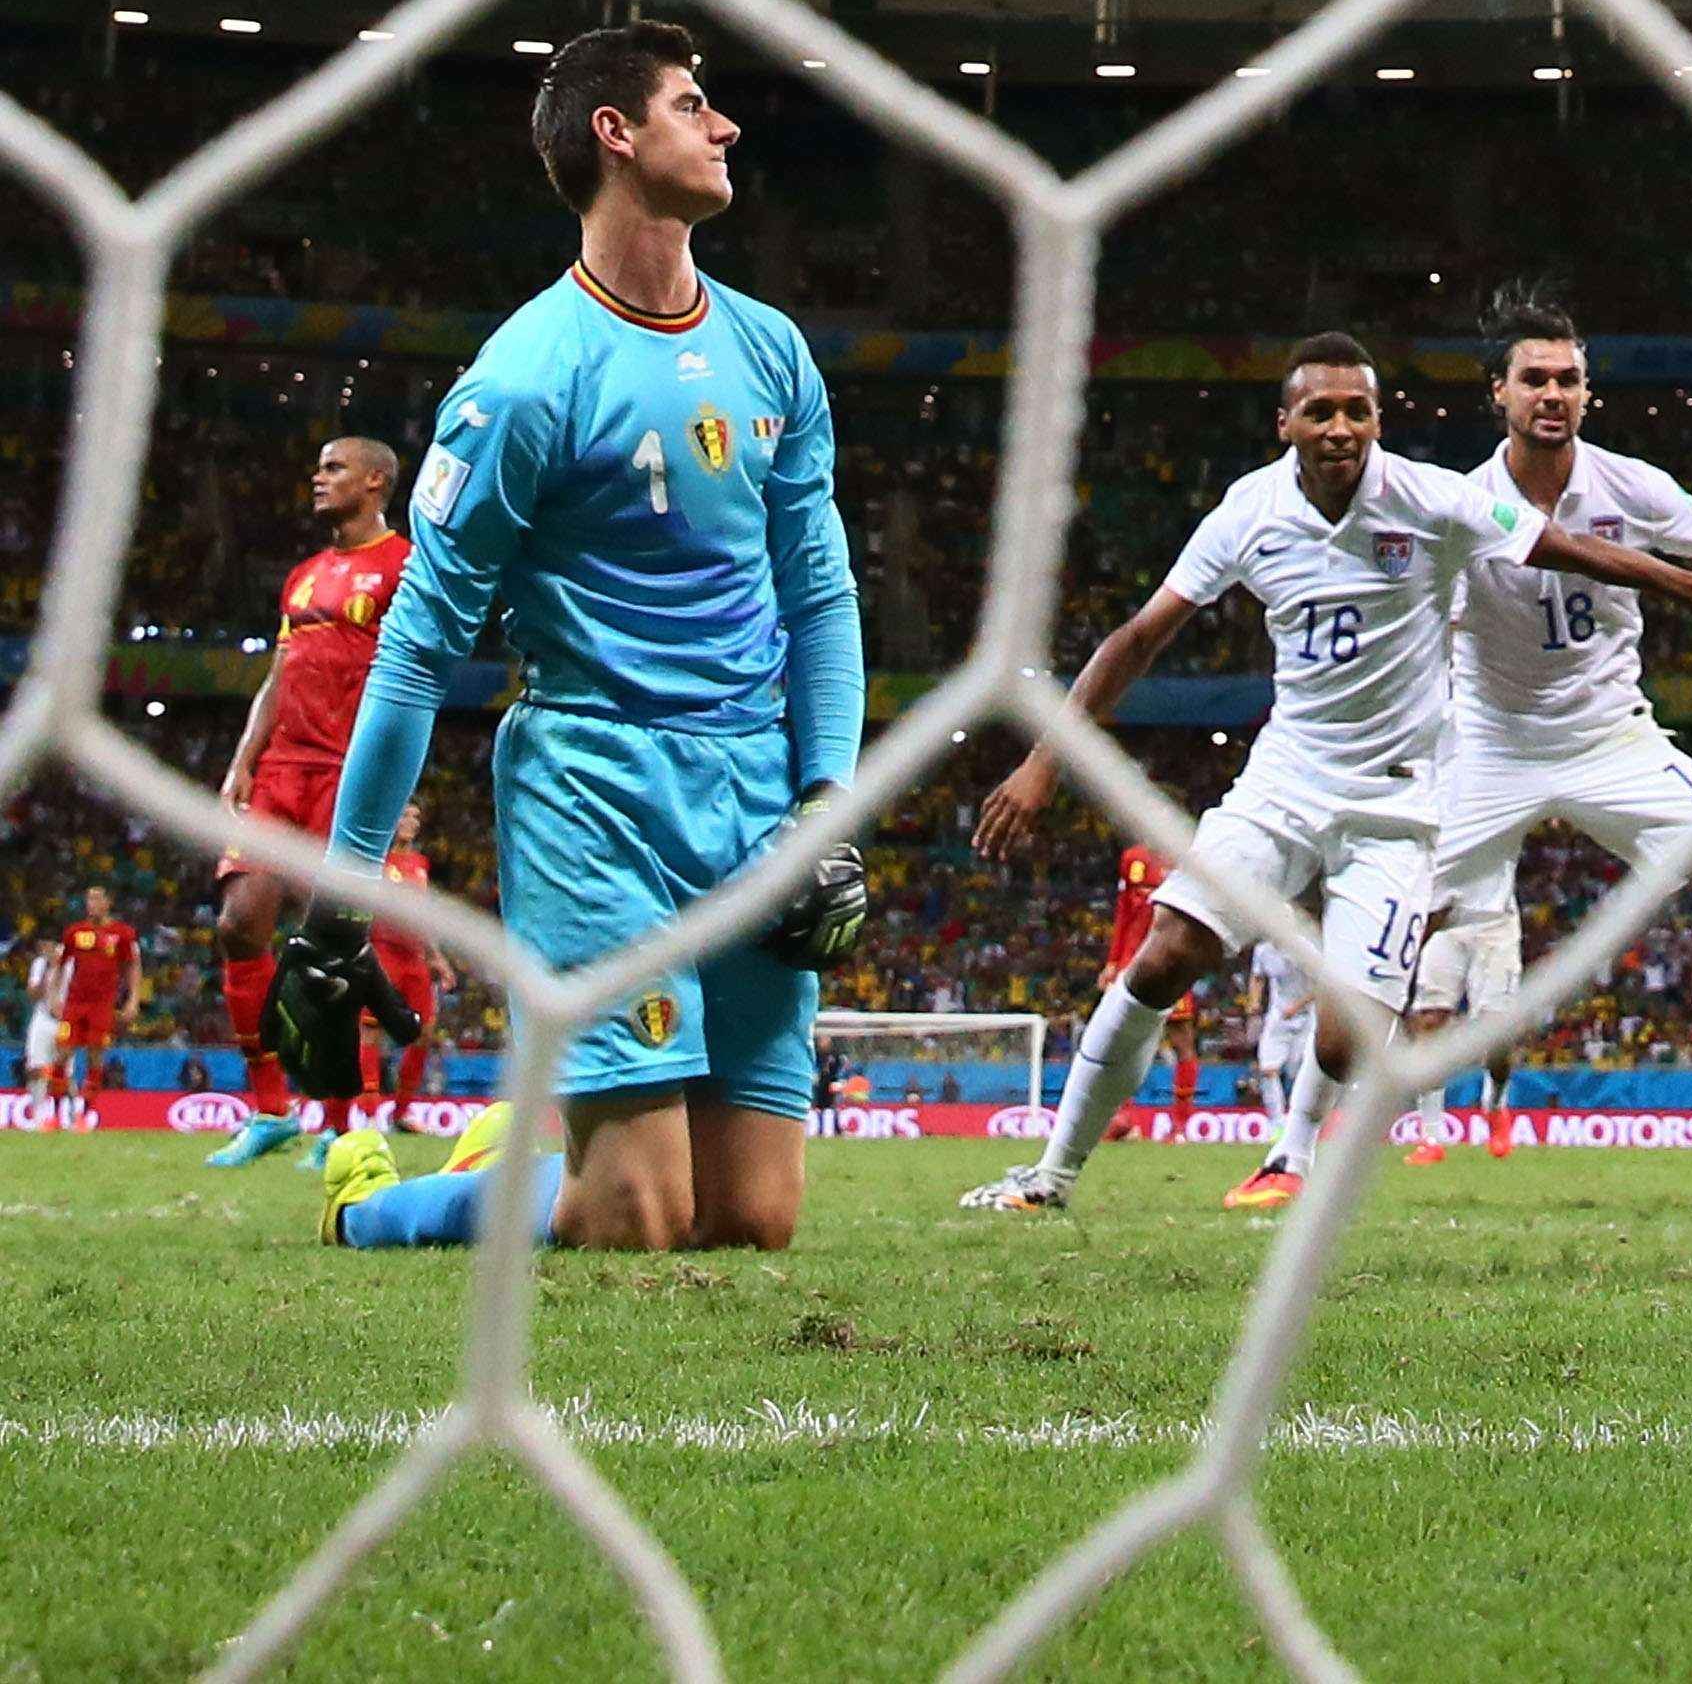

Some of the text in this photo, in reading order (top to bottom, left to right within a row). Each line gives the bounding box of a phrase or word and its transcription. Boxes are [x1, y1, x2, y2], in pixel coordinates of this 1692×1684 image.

[632, 429, 669, 515] 1
[1299, 599, 1363, 663] 16
[1538, 592, 1597, 651] 18
